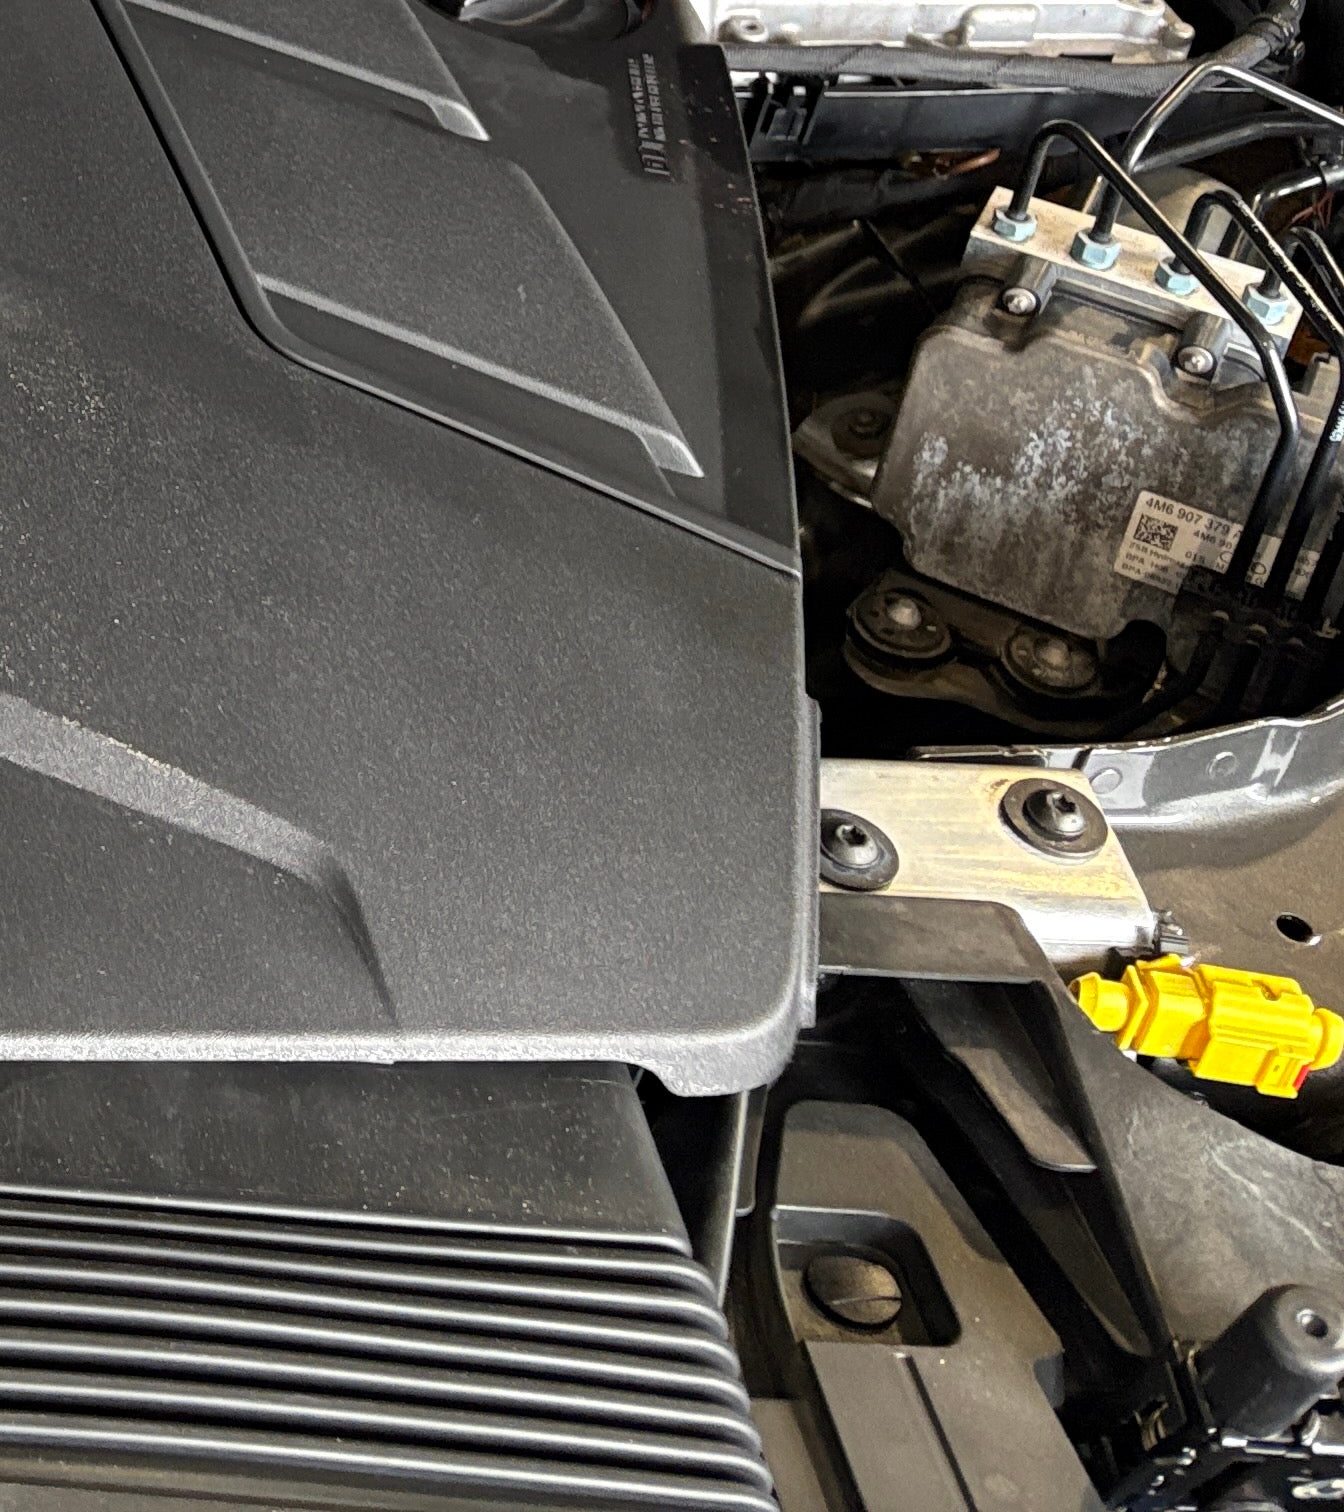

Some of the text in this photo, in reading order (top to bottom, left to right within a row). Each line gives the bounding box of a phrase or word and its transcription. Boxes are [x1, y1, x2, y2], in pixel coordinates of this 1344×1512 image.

[1145, 497, 1174, 516] 4M6
[1177, 507, 1202, 525] 907
[1204, 518, 1231, 535] 379
